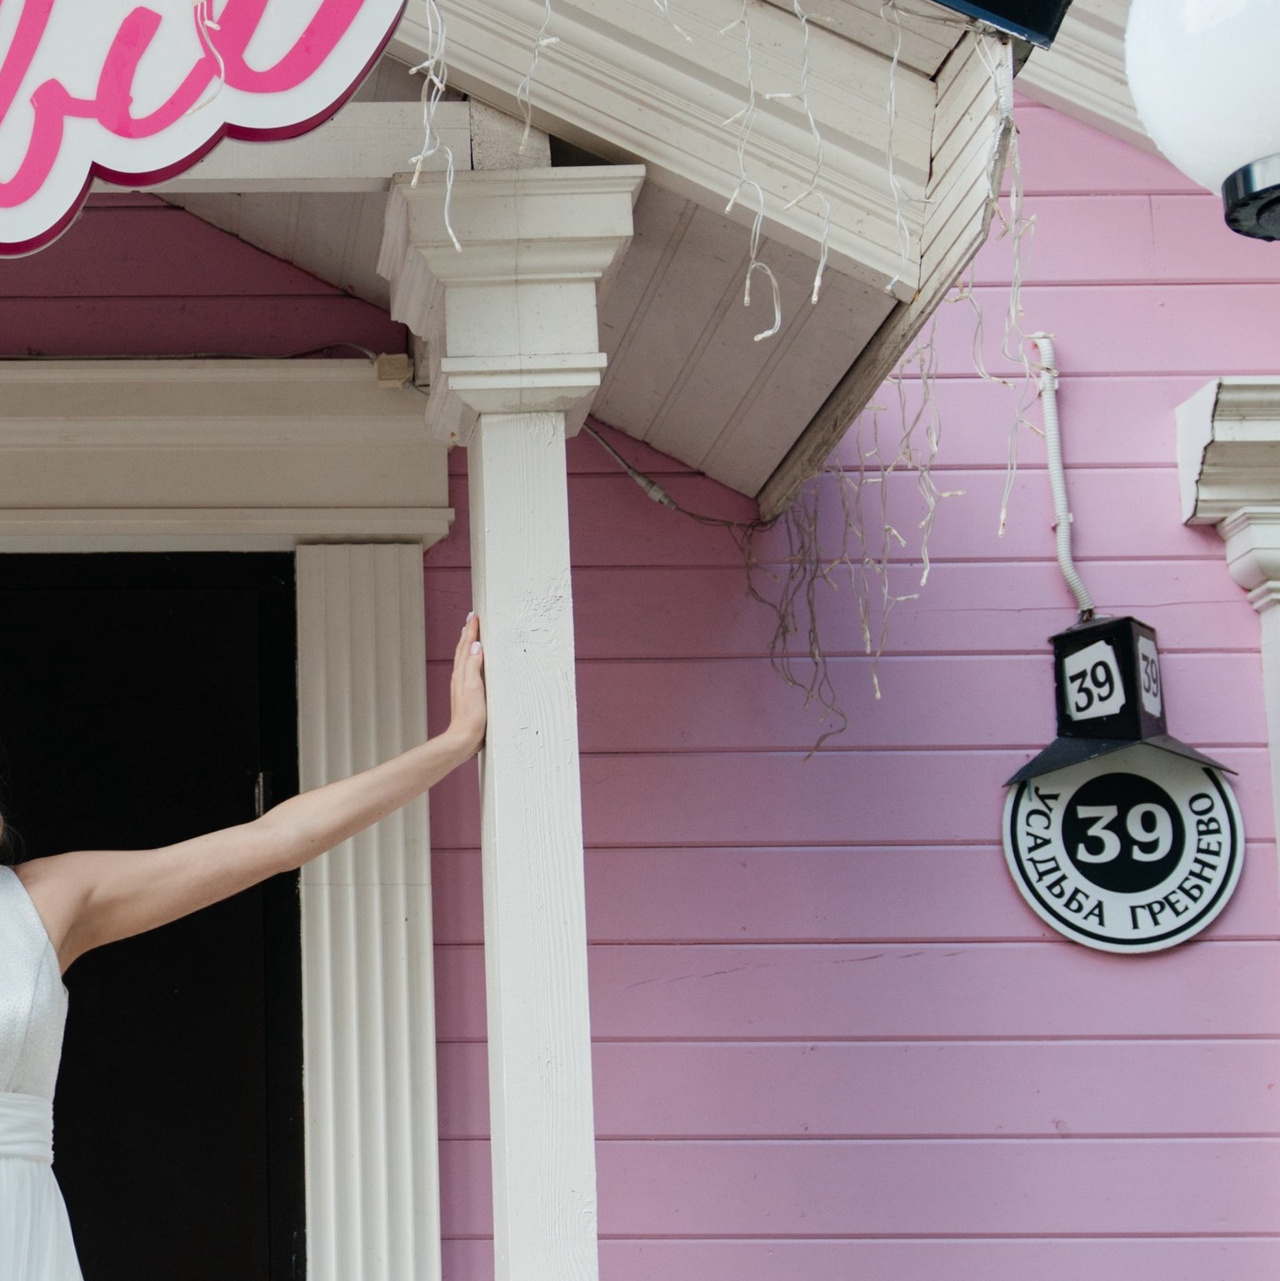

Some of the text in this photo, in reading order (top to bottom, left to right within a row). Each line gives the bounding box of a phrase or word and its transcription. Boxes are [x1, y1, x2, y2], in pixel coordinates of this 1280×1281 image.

[1069, 660, 1115, 713] 39
[1141, 654, 1160, 698] 39
[1025, 786, 1223, 930] УСАДЬБА ГРЕБНЕВО
[1076, 803, 1173, 864] 39
